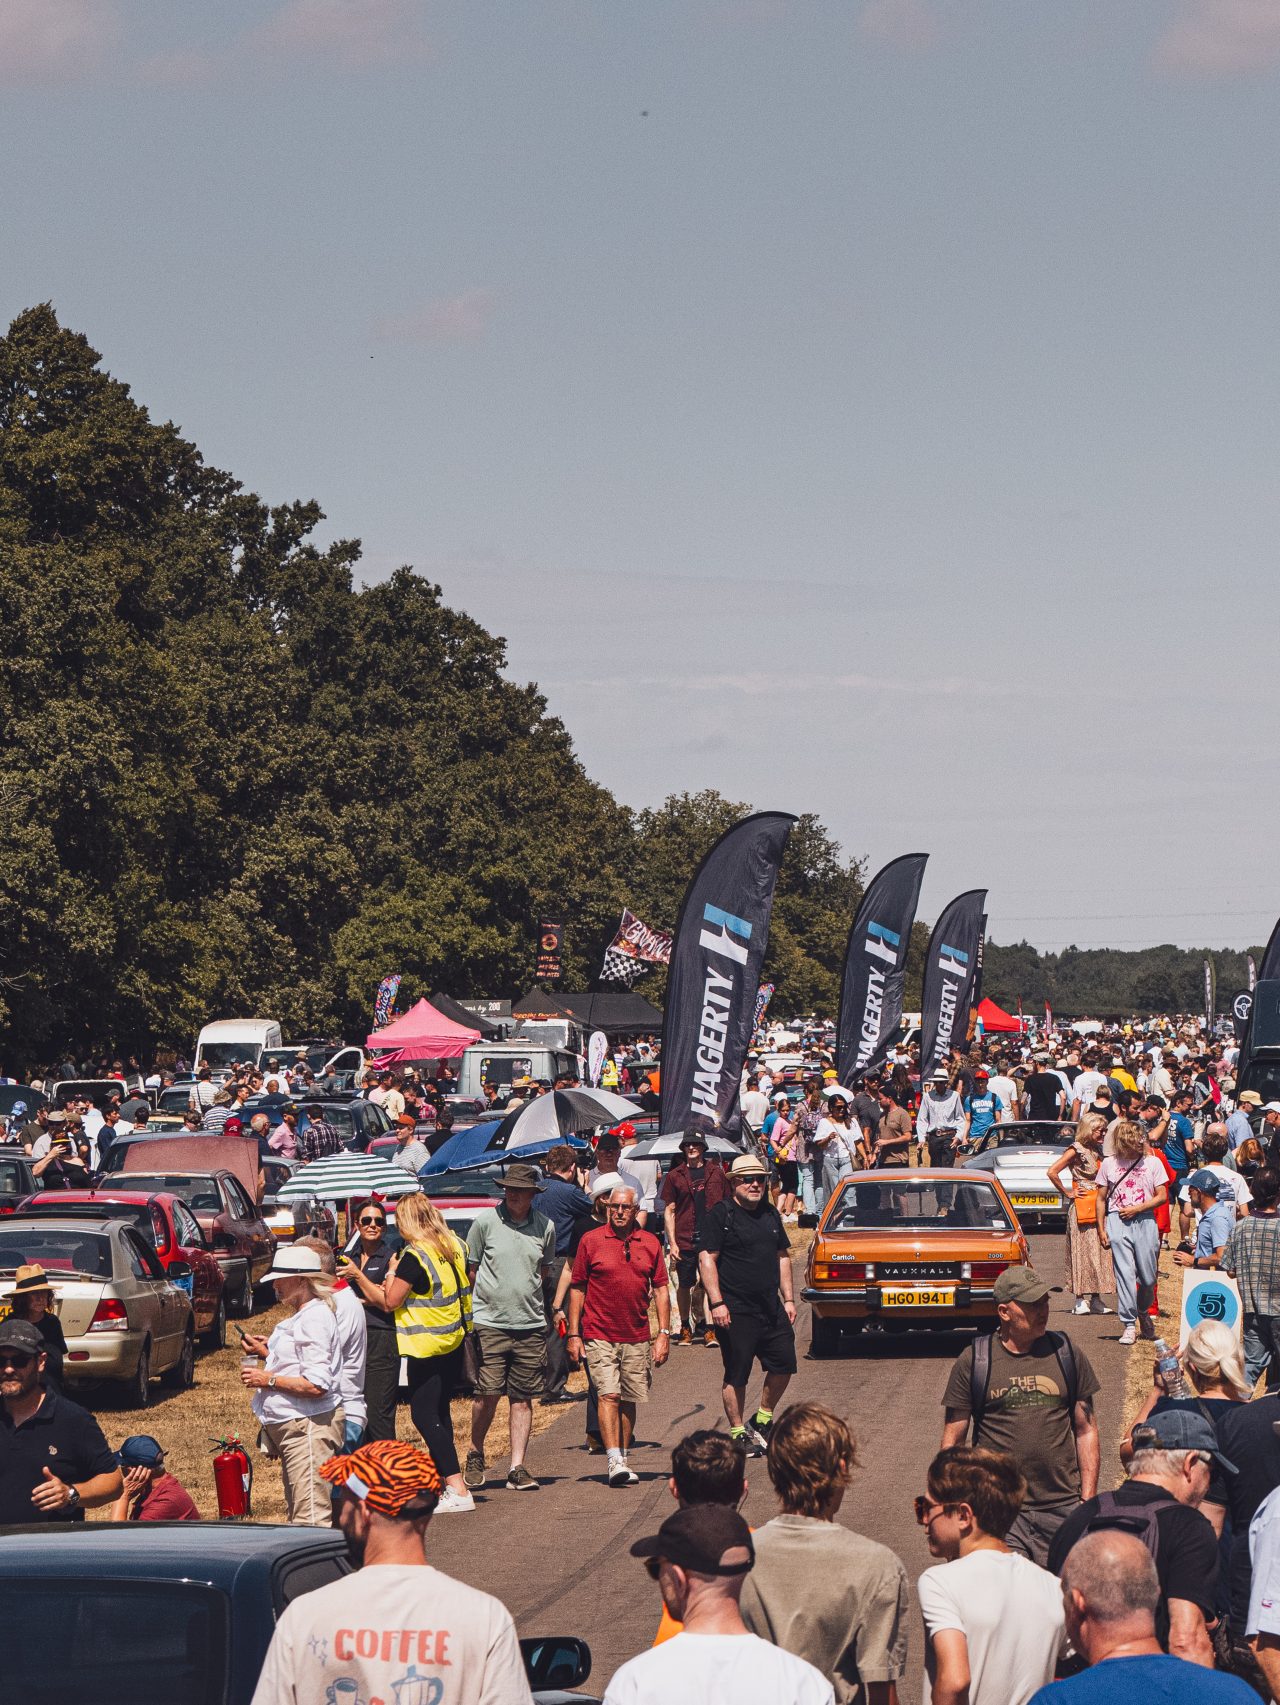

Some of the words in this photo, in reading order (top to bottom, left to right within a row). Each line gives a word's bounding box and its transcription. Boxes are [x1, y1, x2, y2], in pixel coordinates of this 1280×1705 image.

[691, 966, 734, 1123] HAGERTY
[887, 1293, 914, 1304] HGO
[918, 1292, 949, 1304] 194T
[1198, 1291, 1226, 1321] 5
[1009, 1375, 1036, 1386] THE
[335, 1628, 453, 1666] COFFEE
